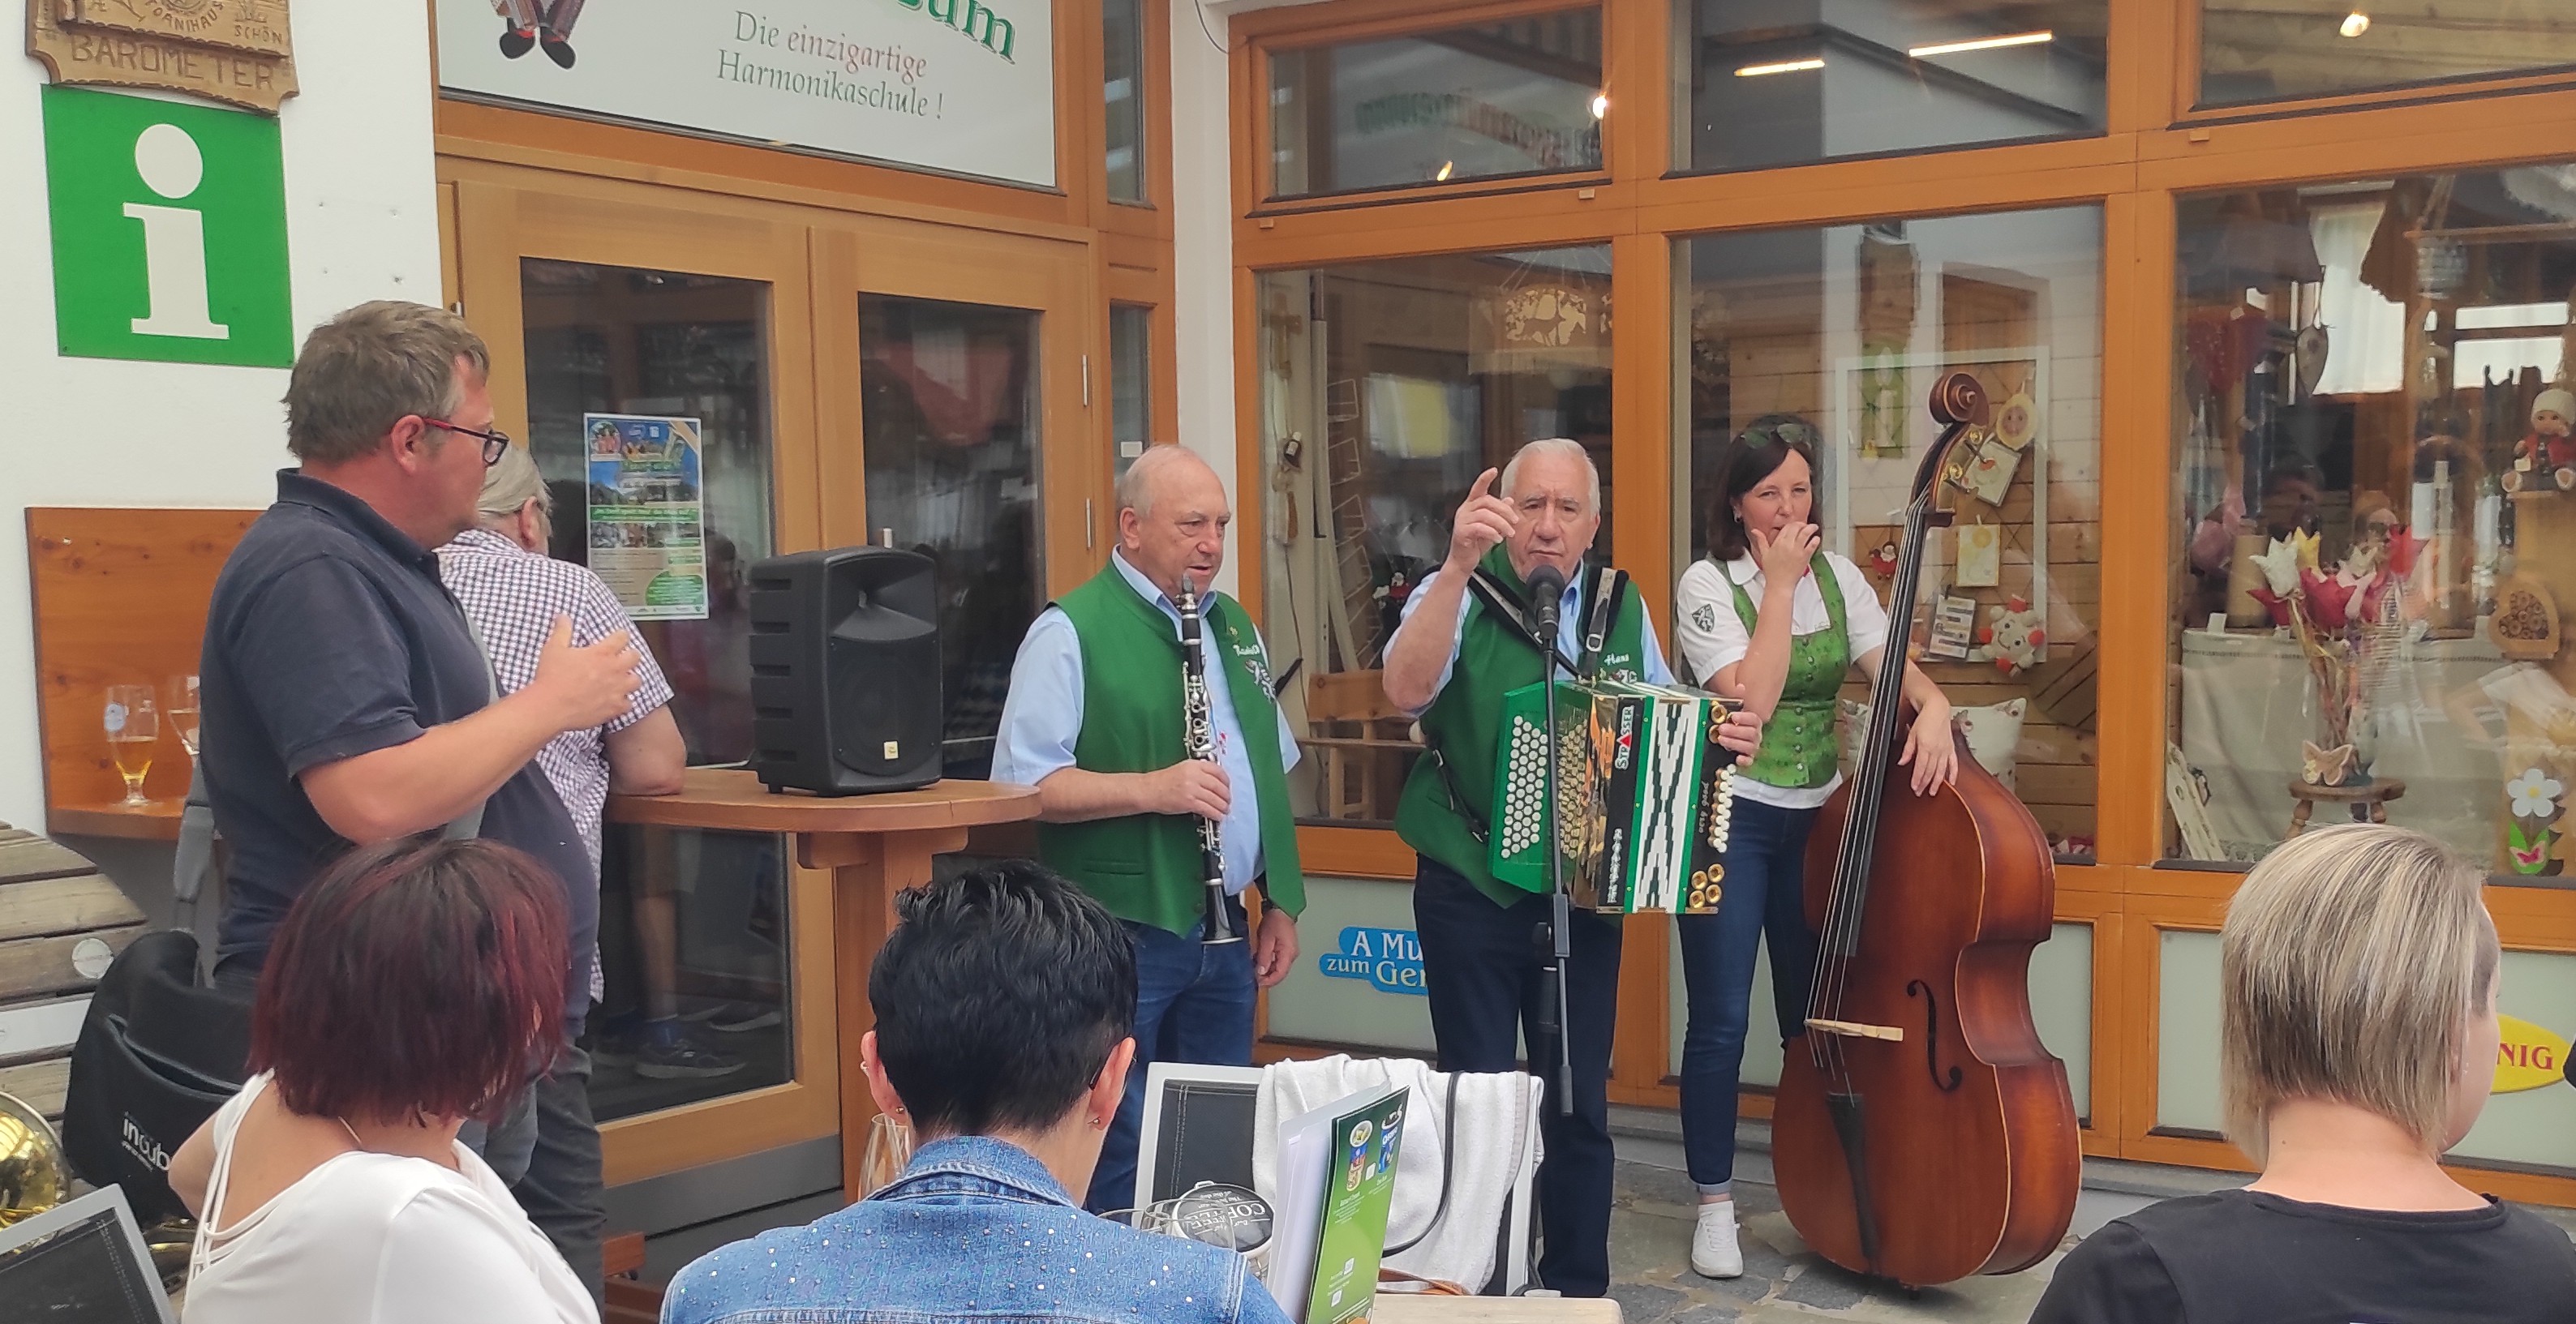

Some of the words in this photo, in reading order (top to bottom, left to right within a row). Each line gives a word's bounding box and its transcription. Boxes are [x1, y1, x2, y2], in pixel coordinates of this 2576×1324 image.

[71, 34, 276, 91] BAROMETER
[735, 10, 779, 49] Die
[788, 24, 928, 85] einzigartige
[717, 49, 930, 118] Harmonikaschule
[936, 92, 944, 120] !
[1326, 958, 1370, 974] zum
[1350, 931, 1372, 957] A
[1381, 932, 1424, 962] Mu
[2496, 1042, 2553, 1070] NIG
